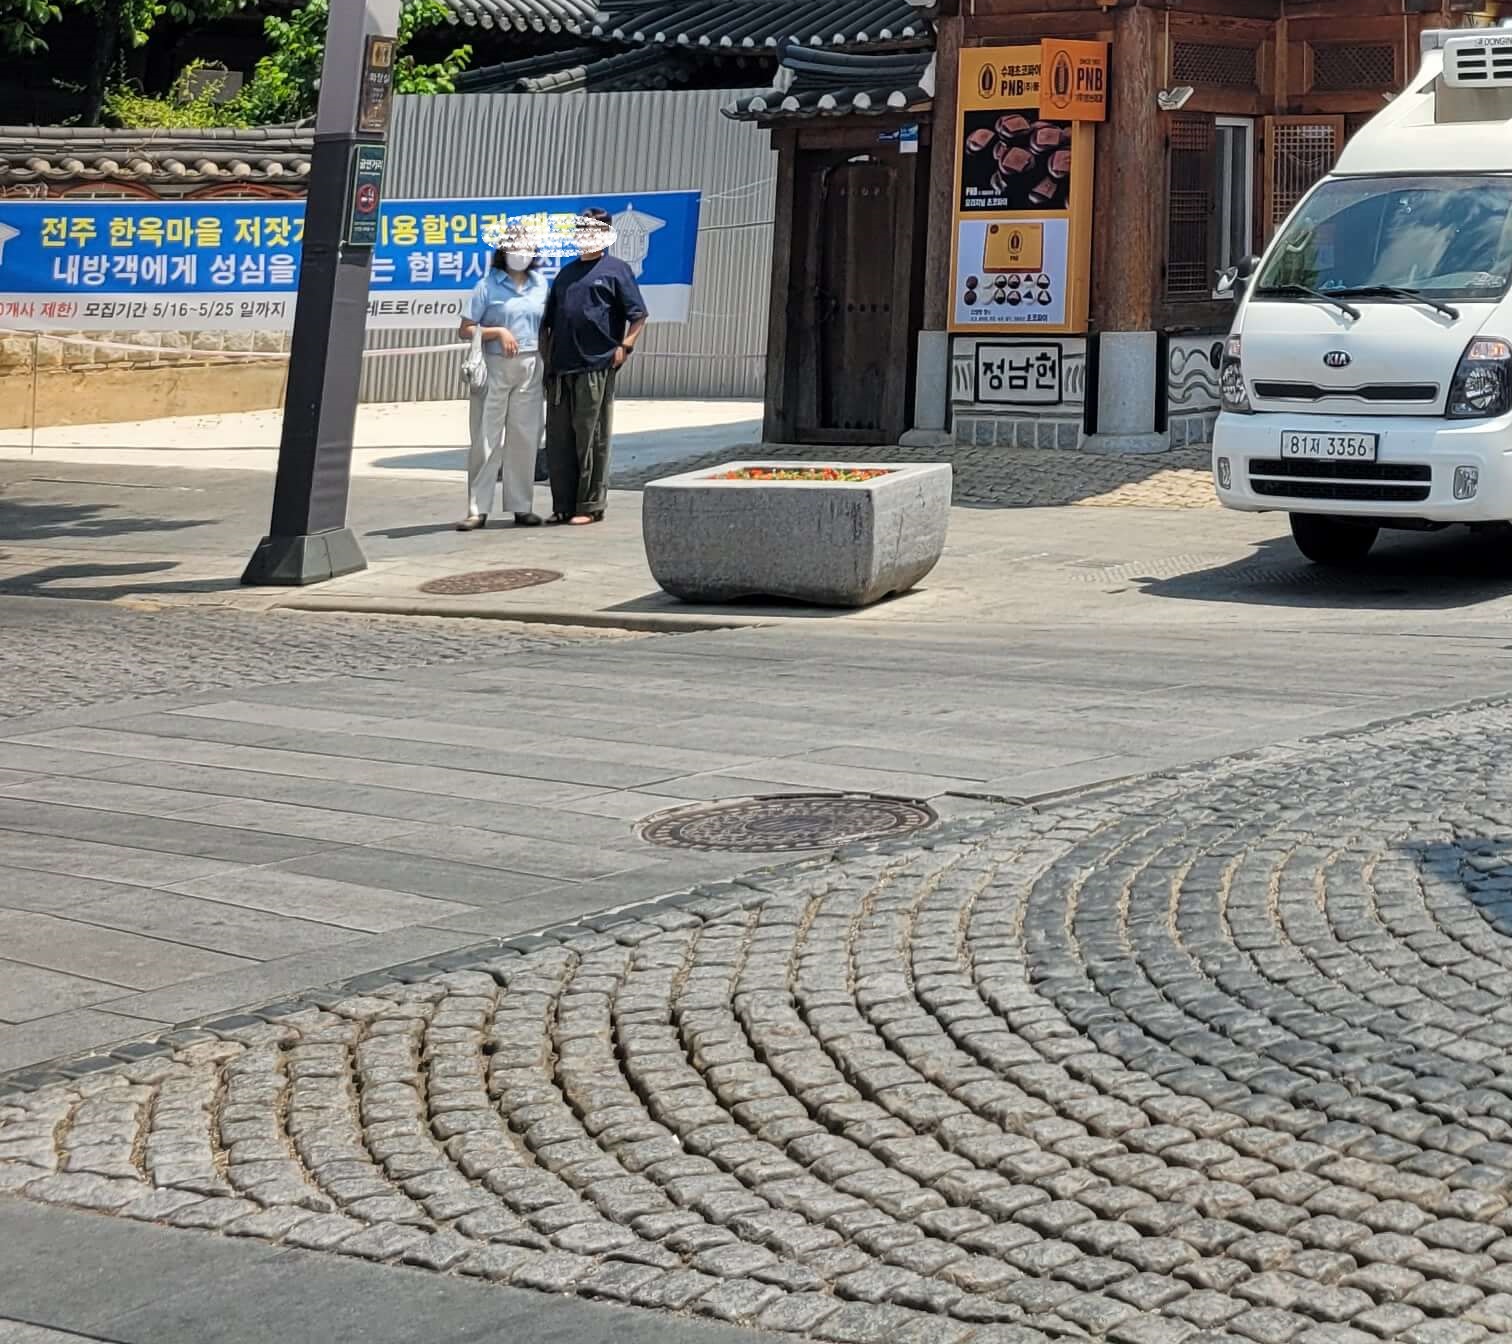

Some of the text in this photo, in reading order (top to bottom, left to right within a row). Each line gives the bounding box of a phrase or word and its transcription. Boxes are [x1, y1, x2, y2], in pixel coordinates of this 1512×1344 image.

[1000, 79, 1024, 97] PNB
[1076, 67, 1104, 92] PNB
[40, 216, 97, 248] 전주
[109, 216, 223, 248] 한옥마을
[53, 254, 197, 286] 내방객에게
[209, 253, 297, 285] 성심을
[39, 301, 79, 319] 제한)
[82, 300, 147, 319] 모집기간
[152, 300, 234, 319] 5/16~5/25
[239, 300, 286, 319] 일까지
[1327, 353, 1348, 365] KIA
[982, 352, 1056, 391] 정남헌
[1326, 437, 1367, 456] 3356
